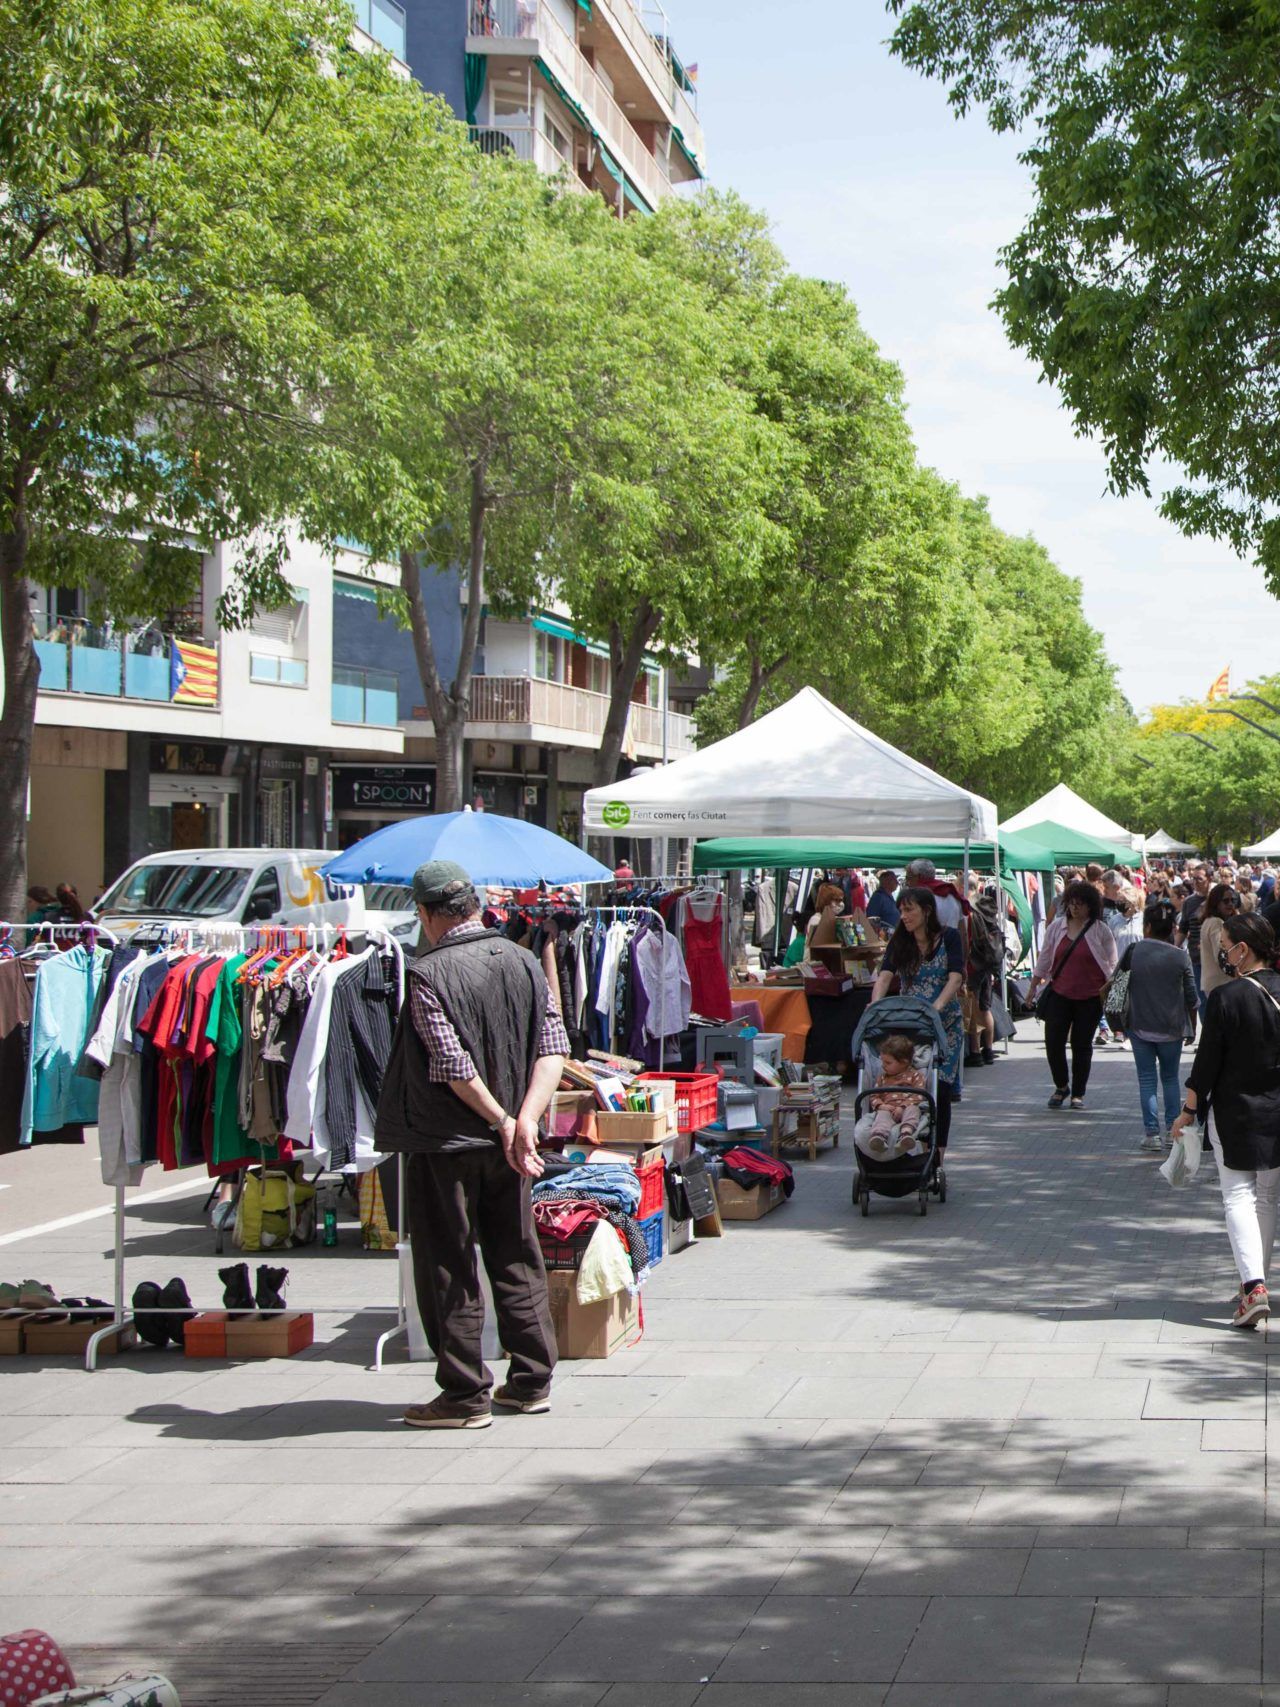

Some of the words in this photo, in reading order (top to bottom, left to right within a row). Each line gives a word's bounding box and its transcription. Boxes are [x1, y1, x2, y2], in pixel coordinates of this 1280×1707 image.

[361, 786, 423, 801] SPOON
[633, 811, 652, 819] Fent
[653, 812, 686, 821] comerç
[687, 810, 700, 820] fas
[701, 811, 727, 820] Ciutat
